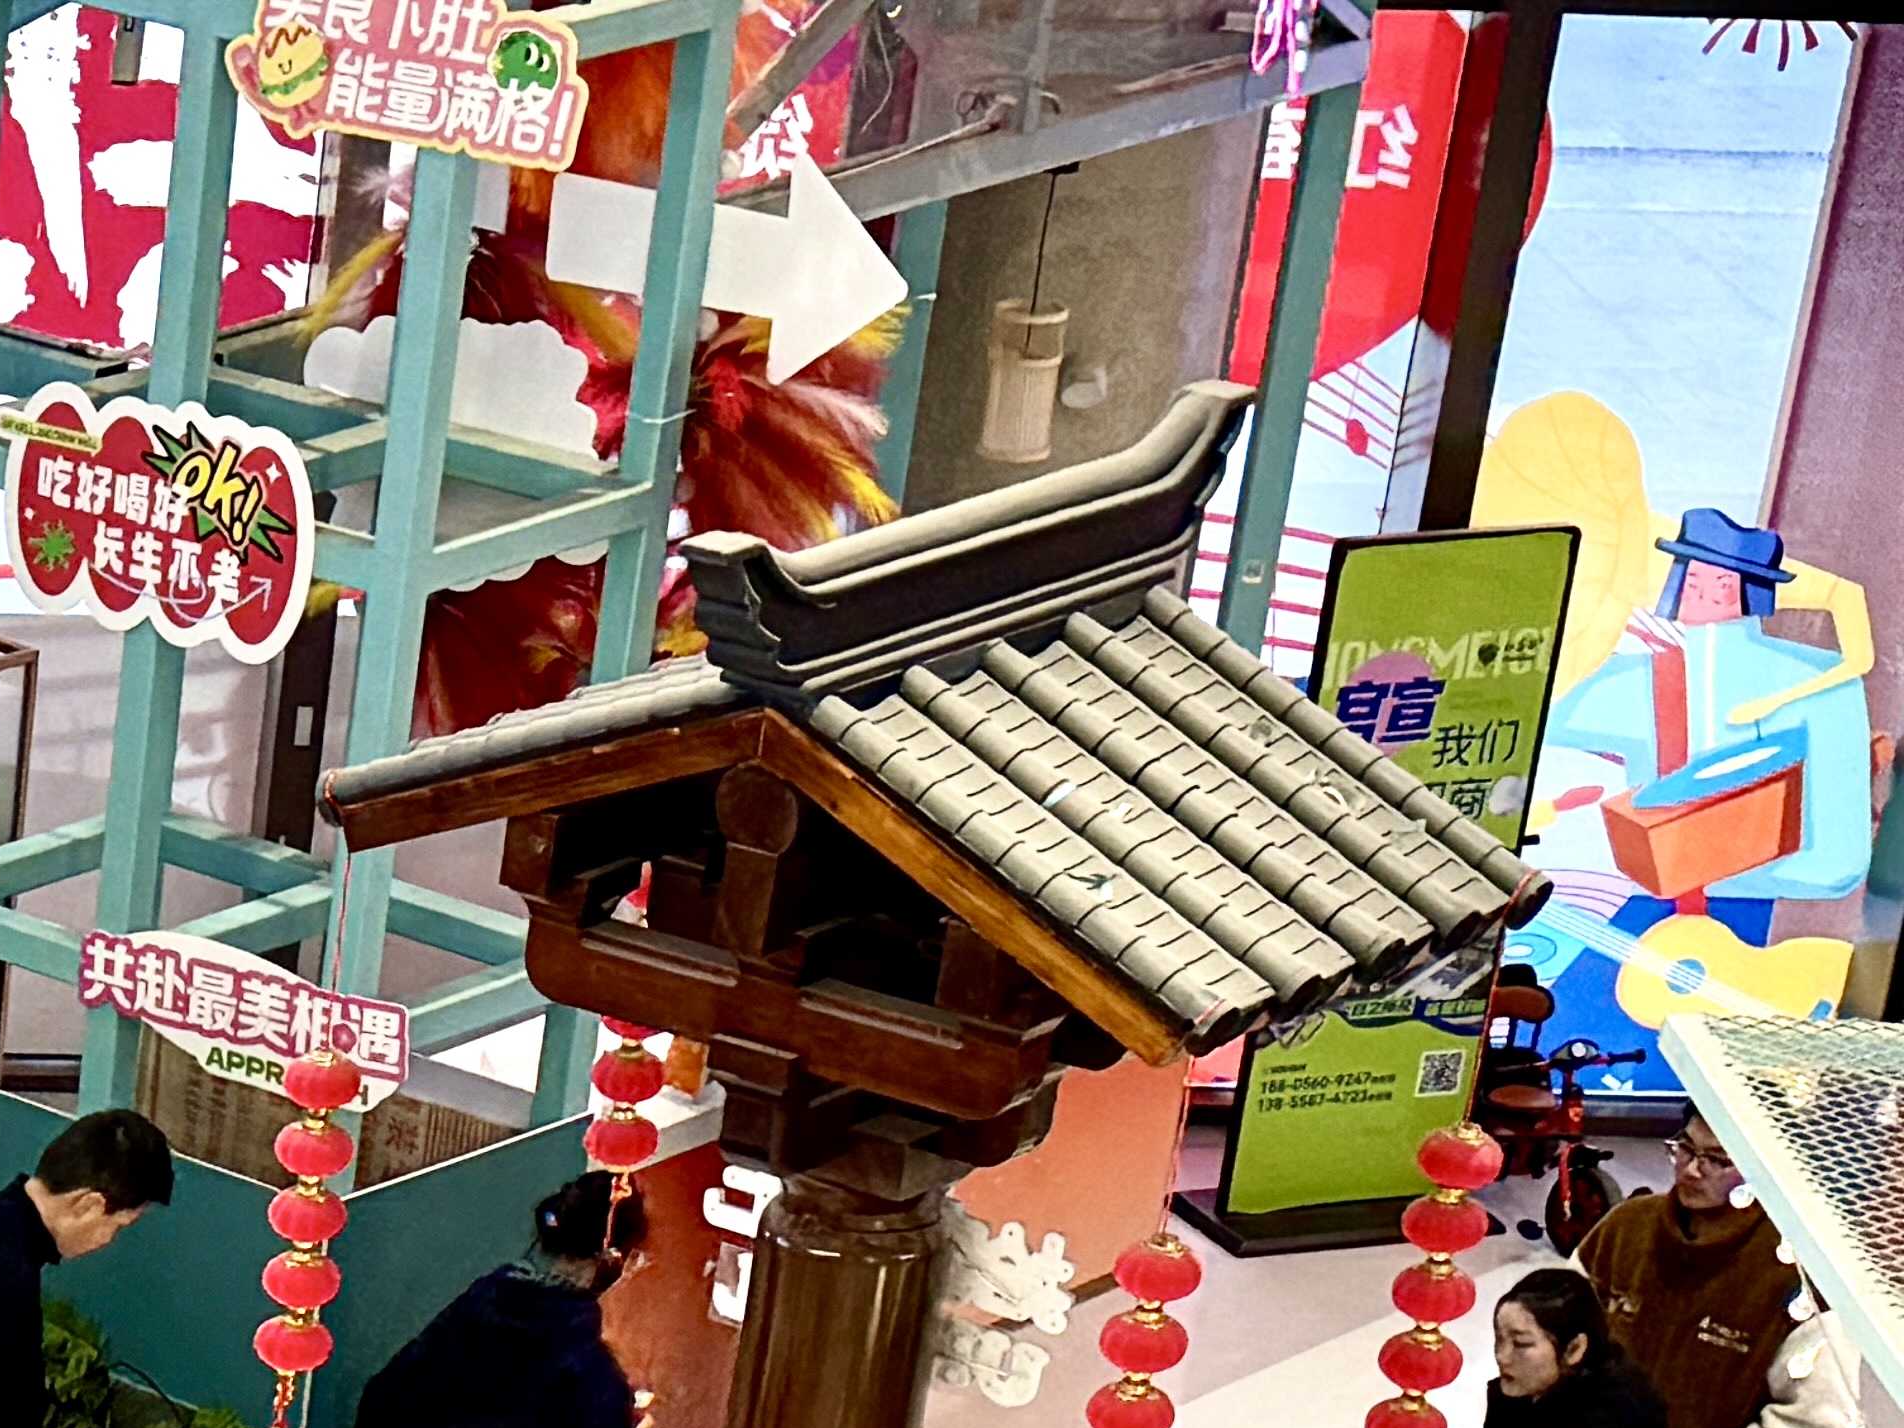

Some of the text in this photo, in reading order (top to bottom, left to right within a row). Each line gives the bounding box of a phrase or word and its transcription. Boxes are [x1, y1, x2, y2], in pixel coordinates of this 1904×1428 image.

[36, 457, 190, 533] 吃好喝好
[1433, 718, 1520, 768] 我们
[83, 941, 400, 1074] 共赴最美相遇
